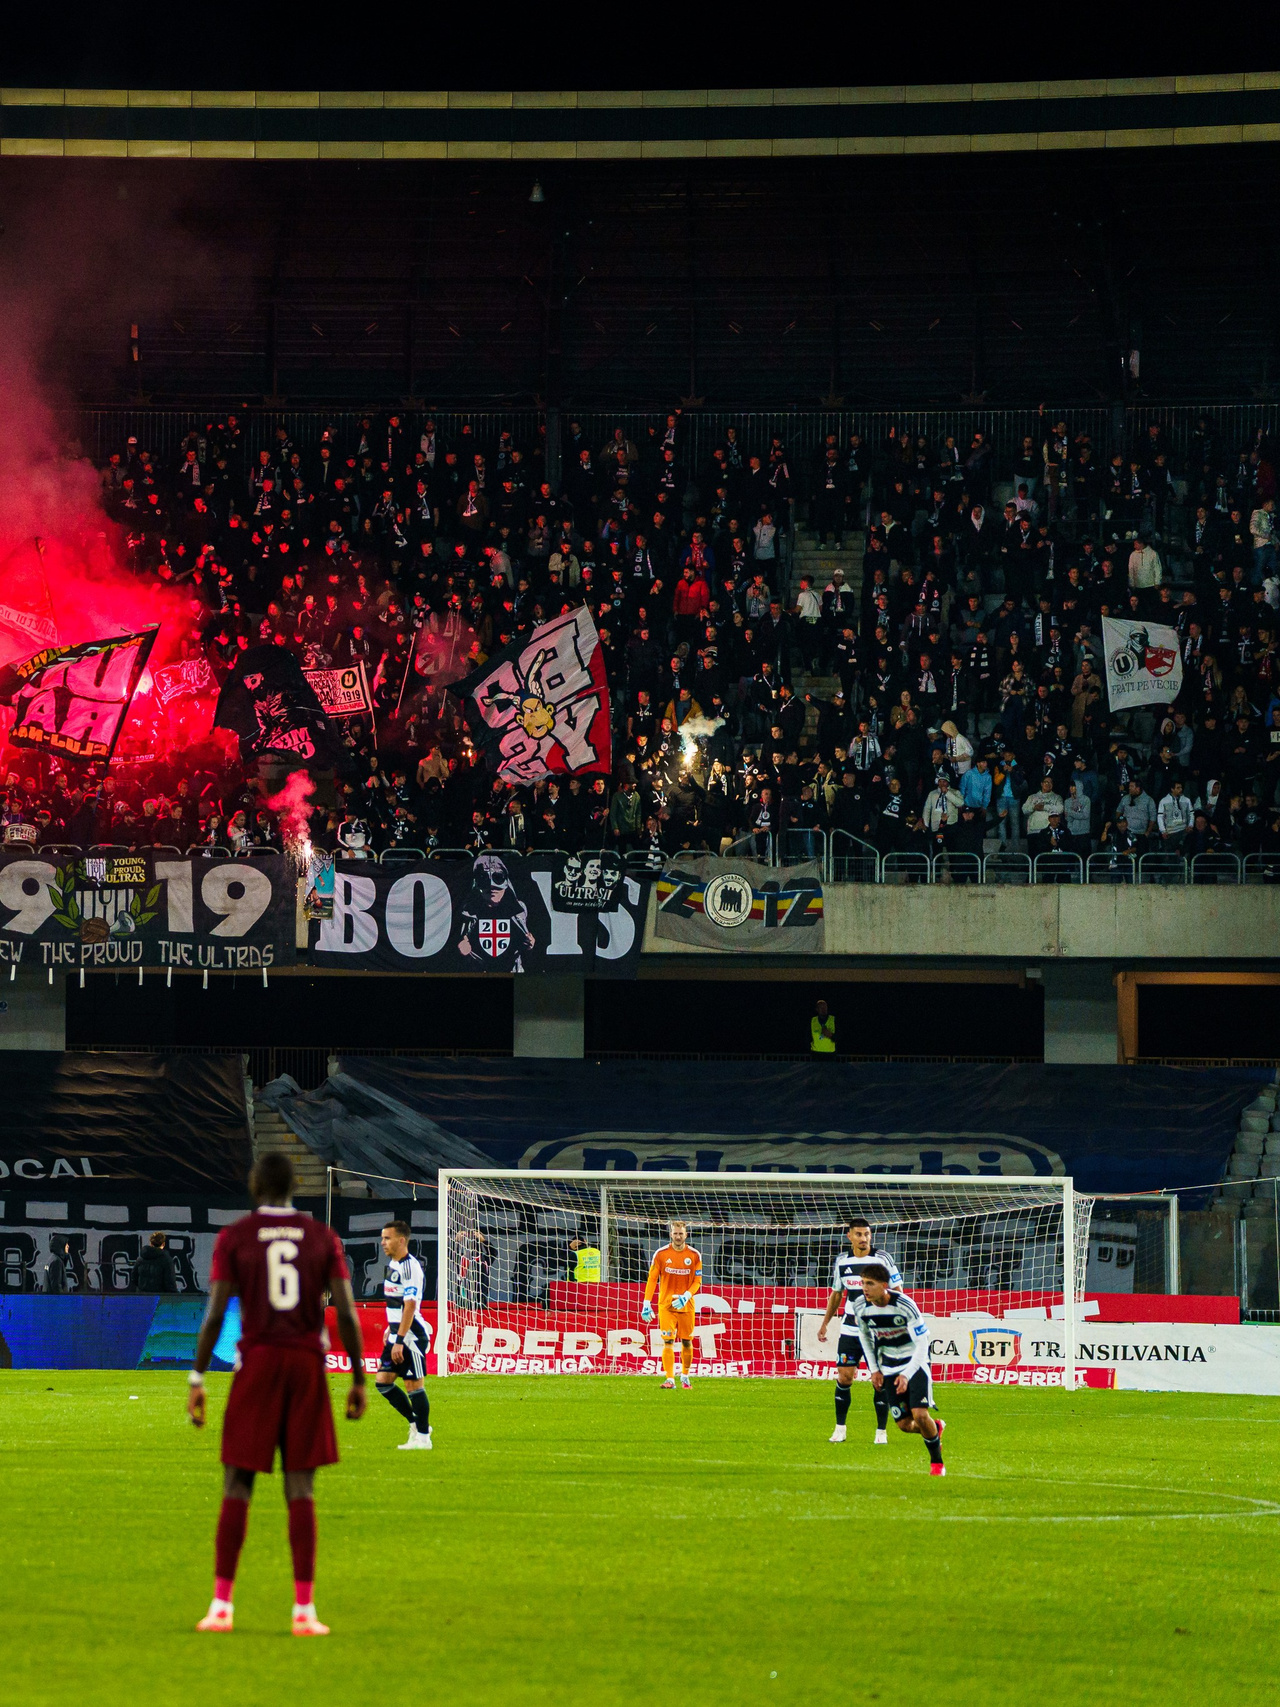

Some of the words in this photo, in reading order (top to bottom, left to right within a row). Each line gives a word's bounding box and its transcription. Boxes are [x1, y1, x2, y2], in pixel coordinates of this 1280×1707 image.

[106, 873, 146, 884] ULTRAS
[40, 941, 75, 965] THE
[81, 940, 144, 966] PROUD
[158, 940, 193, 966] THE
[196, 943, 275, 968] ULTRAS
[266, 1239, 300, 1312] 6
[980, 1340, 1012, 1358] BT
[470, 1353, 595, 1375] SUPERLIGA
